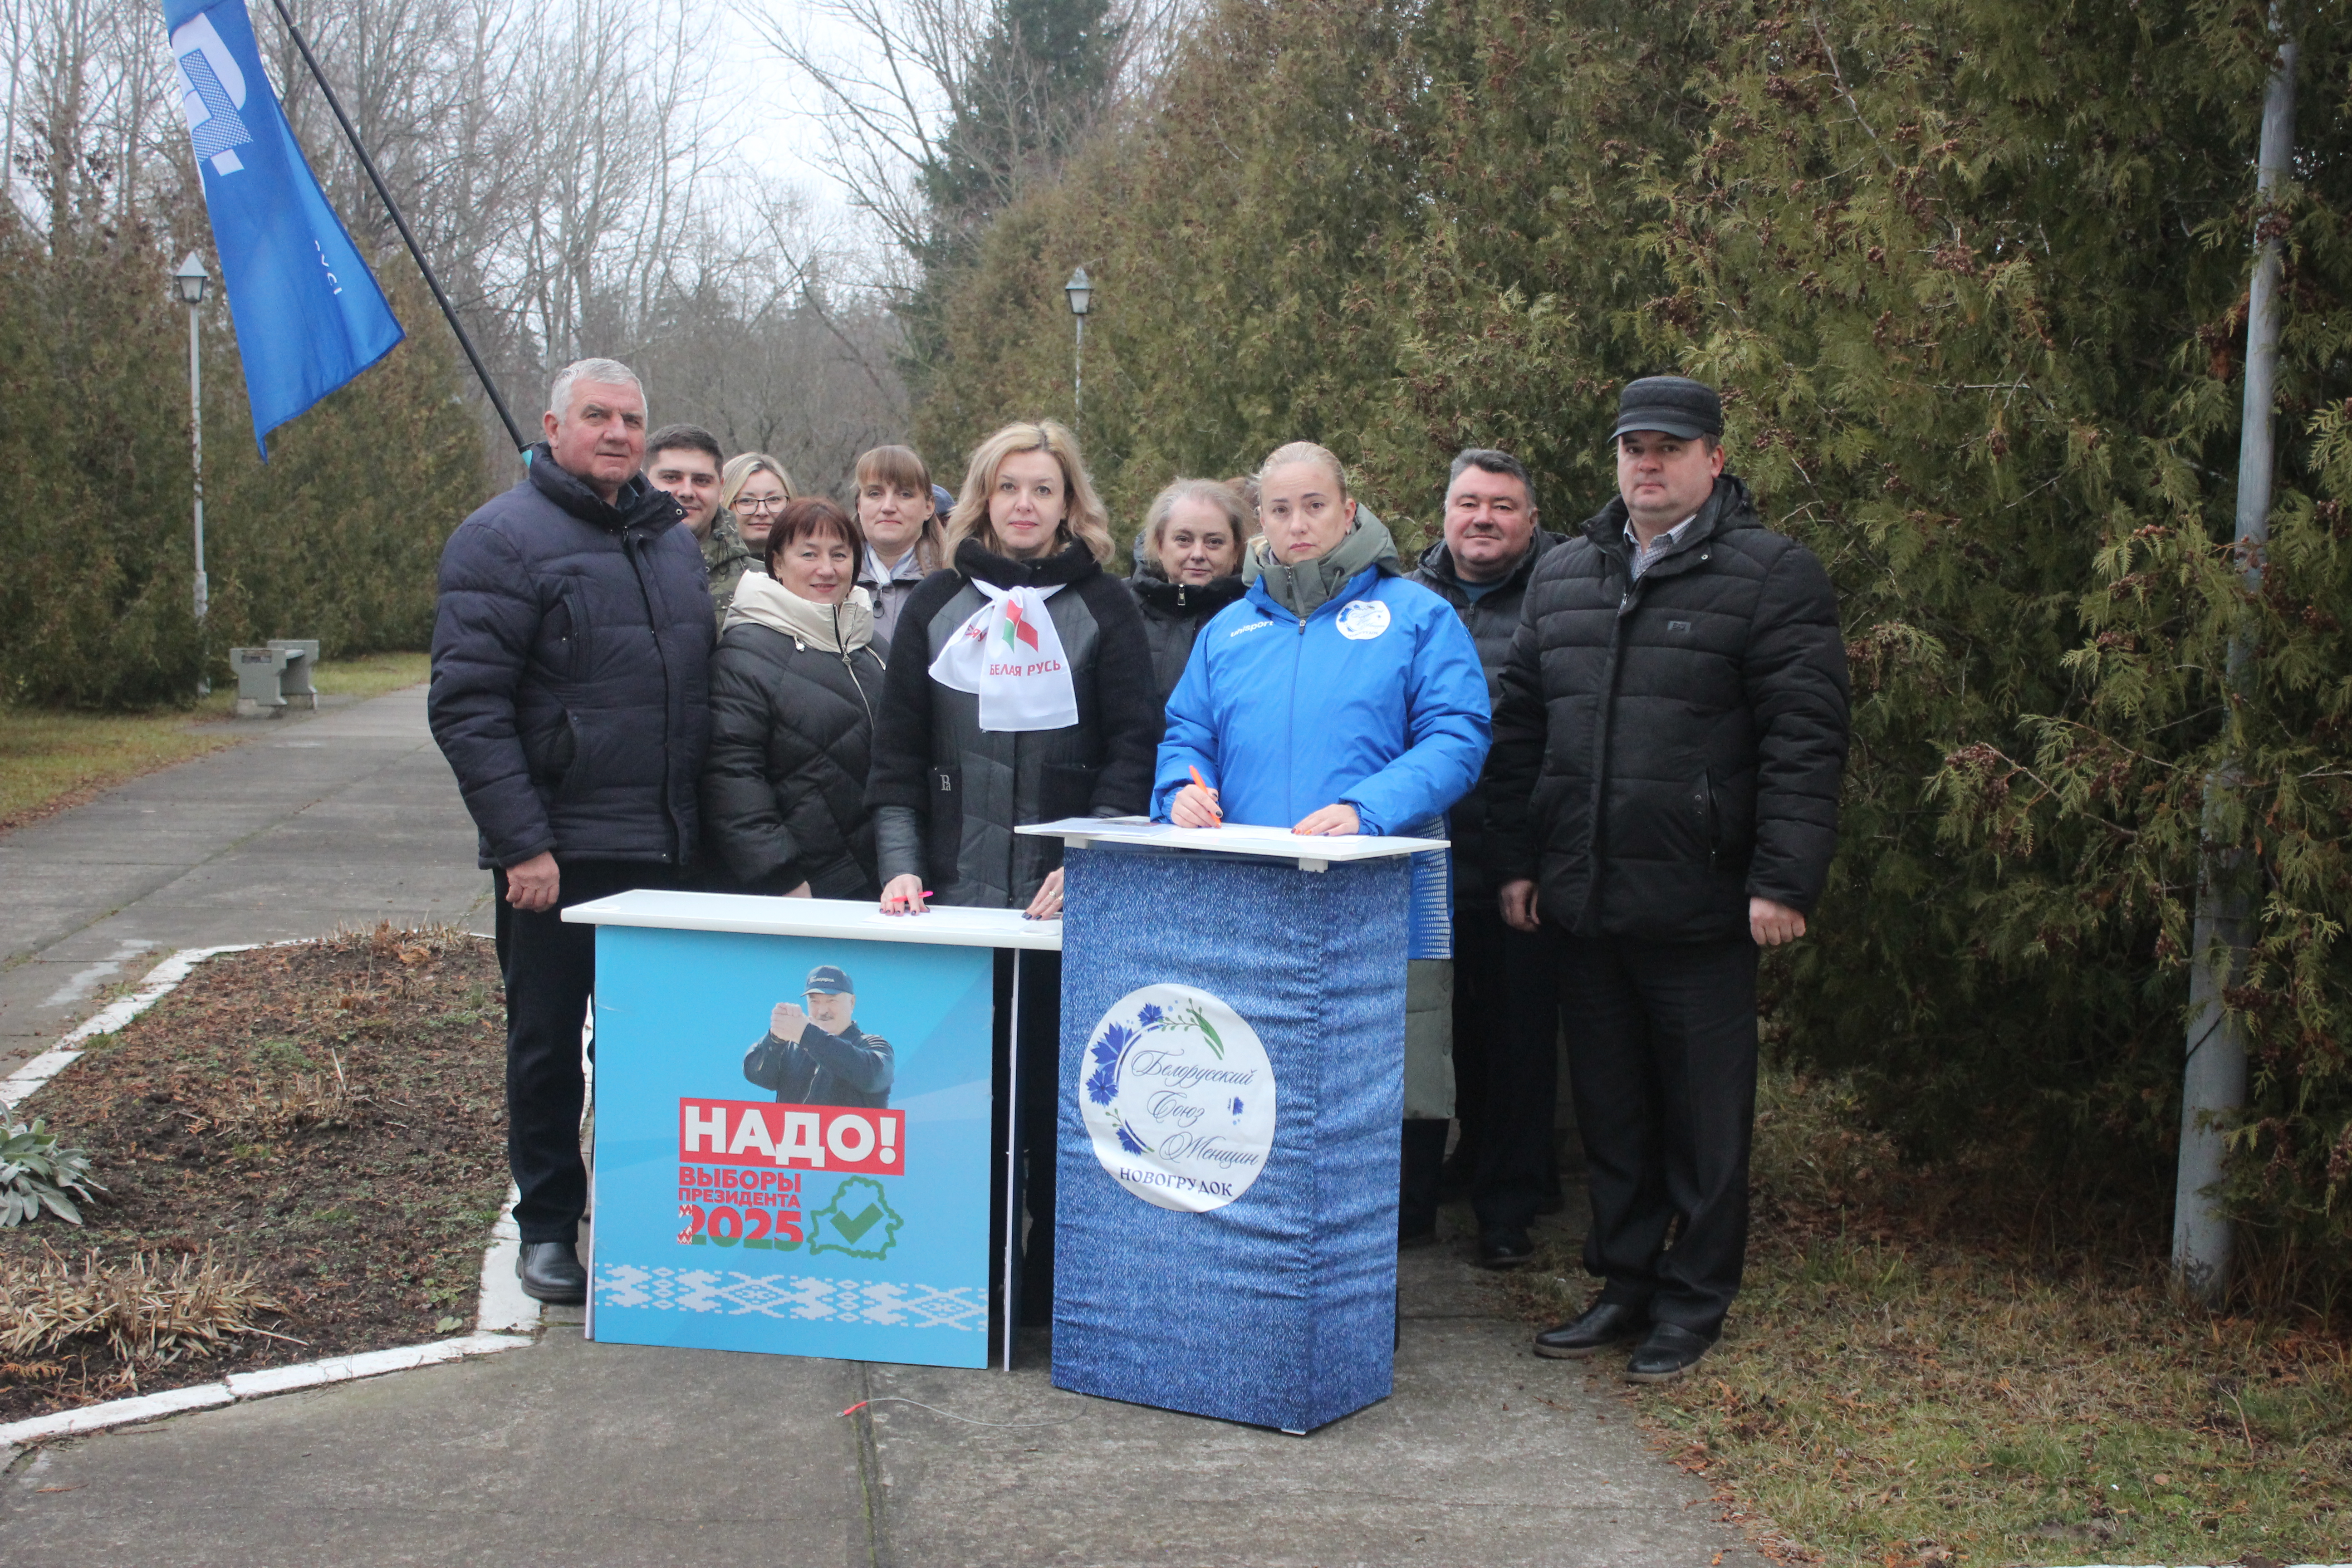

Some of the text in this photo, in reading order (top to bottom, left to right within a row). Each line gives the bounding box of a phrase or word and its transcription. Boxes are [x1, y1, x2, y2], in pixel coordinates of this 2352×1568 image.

[1230, 620, 1274, 637] uhlsport
[989, 659, 1061, 676] БЕЛАЯ РУСЬ
[1131, 1049, 1258, 1089] Белорусский
[1147, 1090, 1205, 1128] Союз
[685, 1106, 897, 1167] НАДО!
[679, 1166, 801, 1193] ВЫБОРЫ
[1119, 1167, 1234, 1197] НОВОГРУДОК
[678, 1187, 801, 1209] ПРЕЗИДЕНТА
[676, 1204, 804, 1252] 2025
